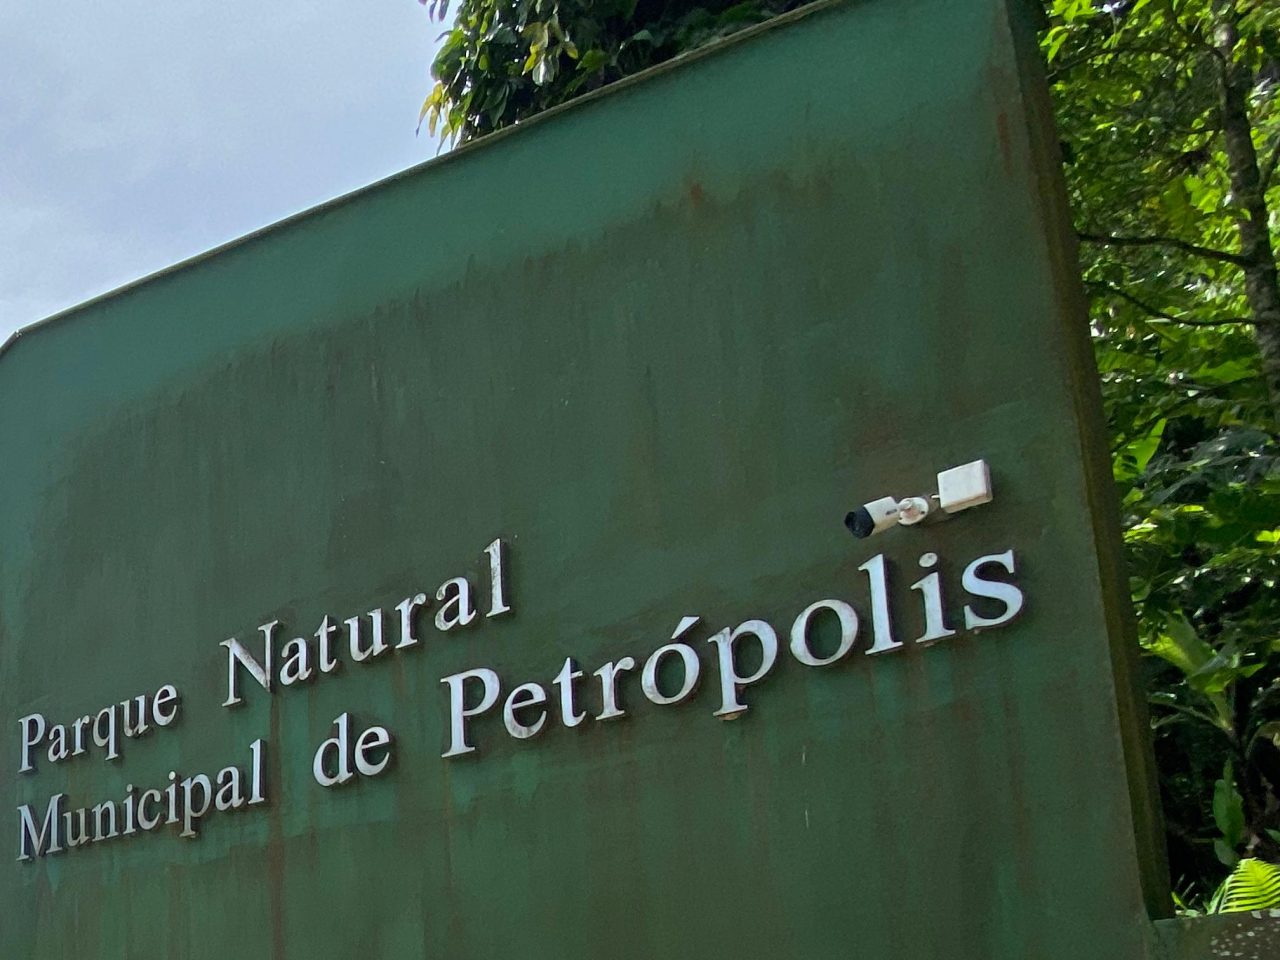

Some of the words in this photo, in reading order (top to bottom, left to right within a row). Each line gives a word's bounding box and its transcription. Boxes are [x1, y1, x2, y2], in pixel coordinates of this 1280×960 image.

[16, 683, 178, 774] Parque
[219, 538, 512, 707] Natural
[16, 738, 266, 862] Municipal
[312, 712, 391, 788] de
[440, 549, 1024, 759] Petrópolis
